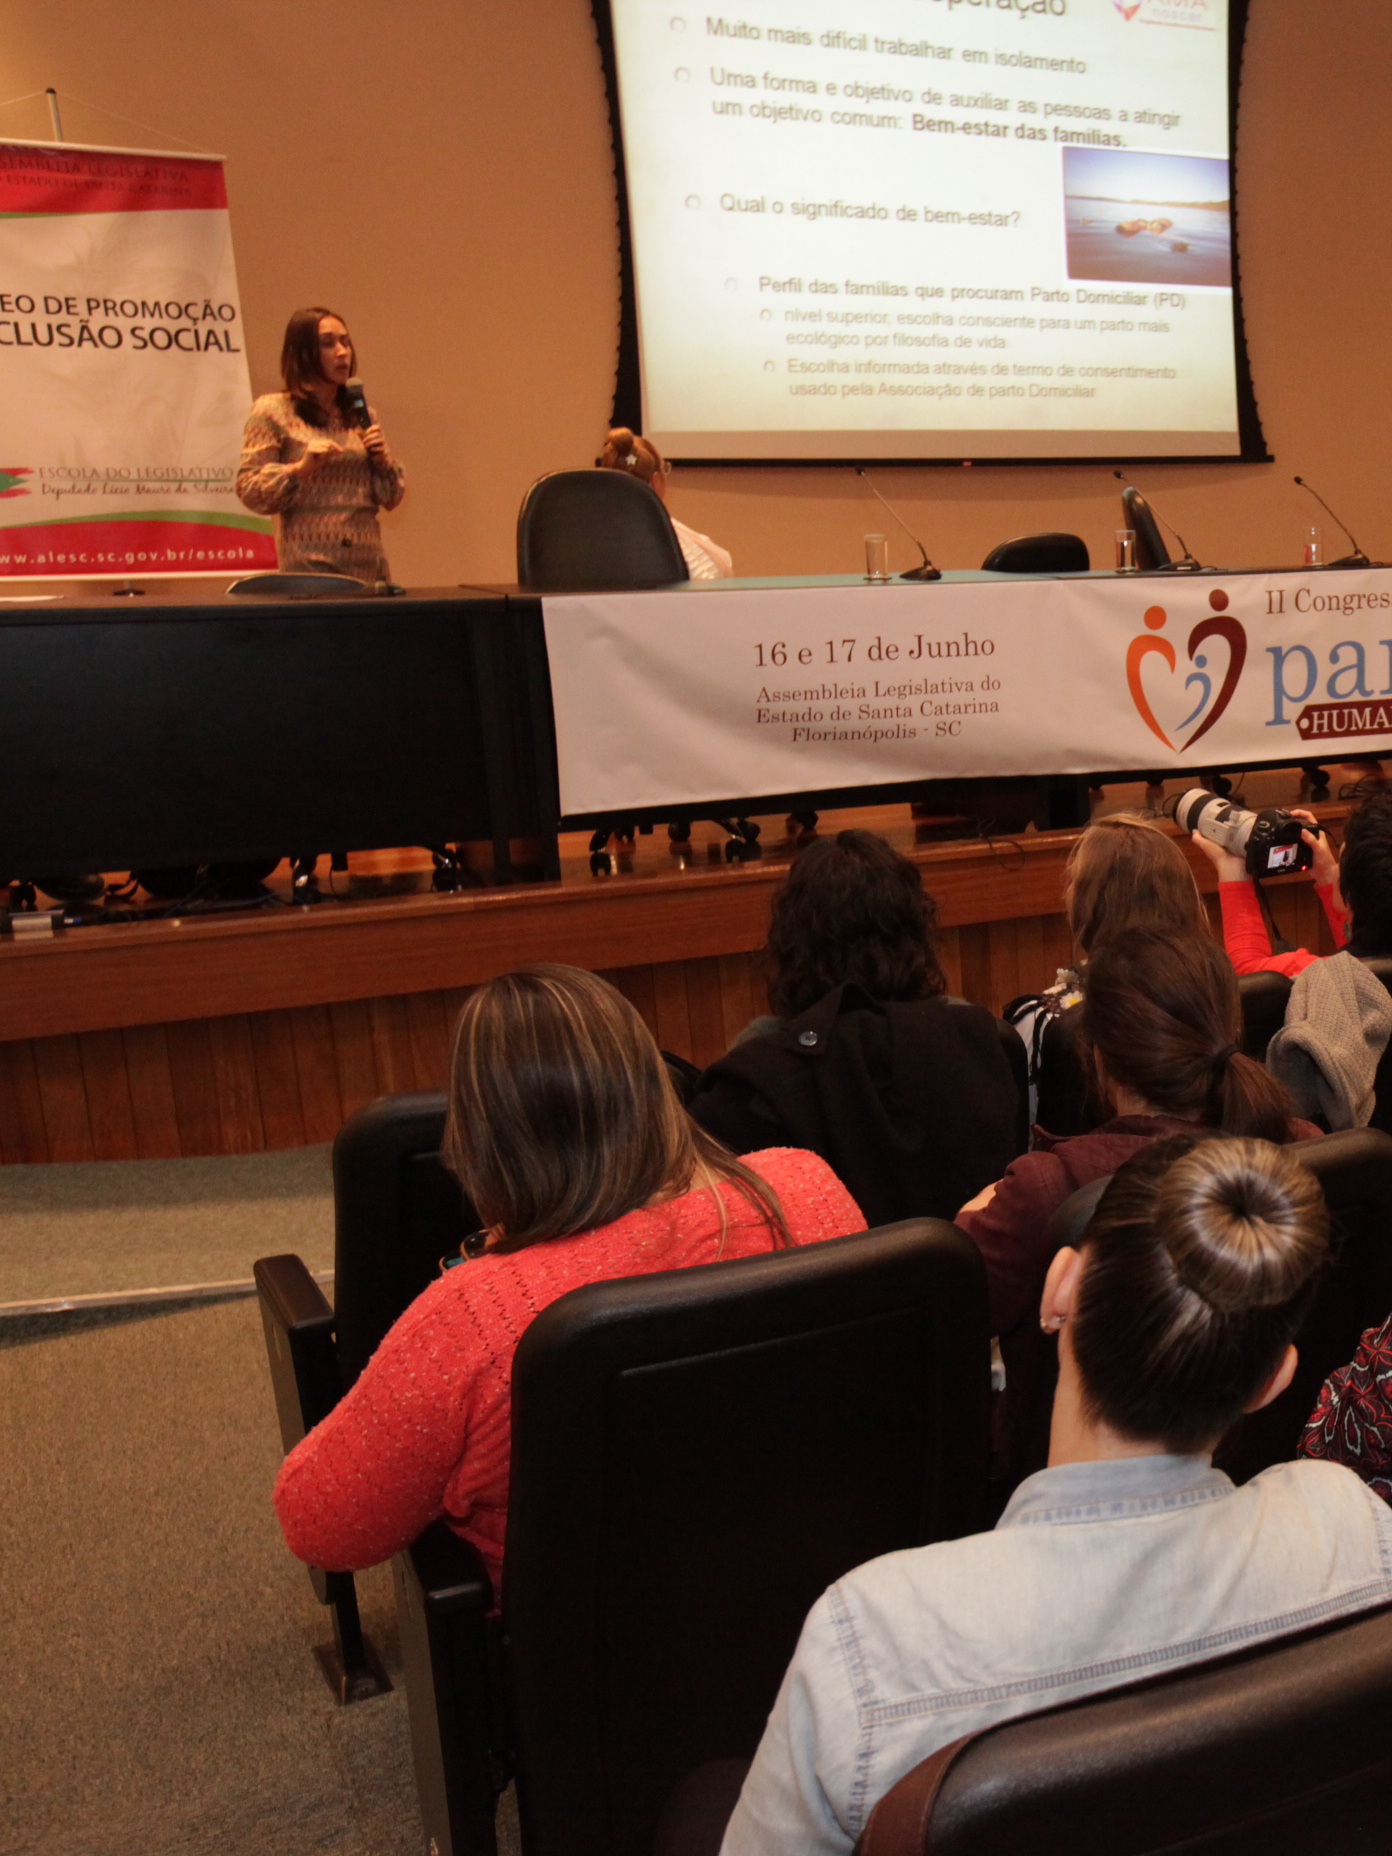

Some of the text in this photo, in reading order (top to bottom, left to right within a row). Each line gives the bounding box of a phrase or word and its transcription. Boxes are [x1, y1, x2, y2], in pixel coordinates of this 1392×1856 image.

[706, 16, 761, 40] Muito
[768, 27, 812, 46] mais
[874, 36, 953, 60] trabalhar
[962, 48, 988, 64] em
[995, 48, 1086, 74] isolamento
[710, 66, 1181, 130] Uma forma e objetivo de auxiliar as pessoas a atingir
[712, 100, 1127, 148] um objetivo comum: Bem-estar das famílias.
[720, 193, 1020, 228] Qual o significado de bem-estar?
[759, 276, 802, 293] Perfil
[808, 279, 838, 295] das
[915, 285, 944, 301] que
[951, 287, 1023, 302] procuram
[1031, 286, 1070, 302] Parto
[1076, 288, 1148, 306] Domiciliar
[1154, 292, 1186, 311] (PD)
[44, 295, 80, 316] DE
[86, 297, 236, 326] PROMOÇÃO
[826, 309, 891, 327] superior,
[897, 311, 953, 326] escolha
[959, 313, 1035, 329] consciente
[1040, 319, 1070, 333] para
[1075, 320, 1096, 331] um
[1100, 319, 1134, 334] parto
[1138, 320, 1170, 333] mais
[0, 318, 241, 353] CLUSÃO SOCIAL
[786, 331, 1007, 349] ecológico por filosofia de vida
[787, 358, 1176, 380] Escolha informada através de termo de consentimento
[789, 382, 1096, 400] usado pela Associação de parto Domiciliar
[39, 467, 234, 480] ESCOLA DO LEGISLATIVO
[1265, 589, 1285, 615] II
[754, 632, 995, 668] 16 e 17 de Junho
[756, 674, 1001, 704] Assembleia Legislativa do
[756, 698, 1000, 725] Estado de Santa Catarina
[791, 723, 917, 743] Florianópolis
[935, 720, 962, 738] SC
